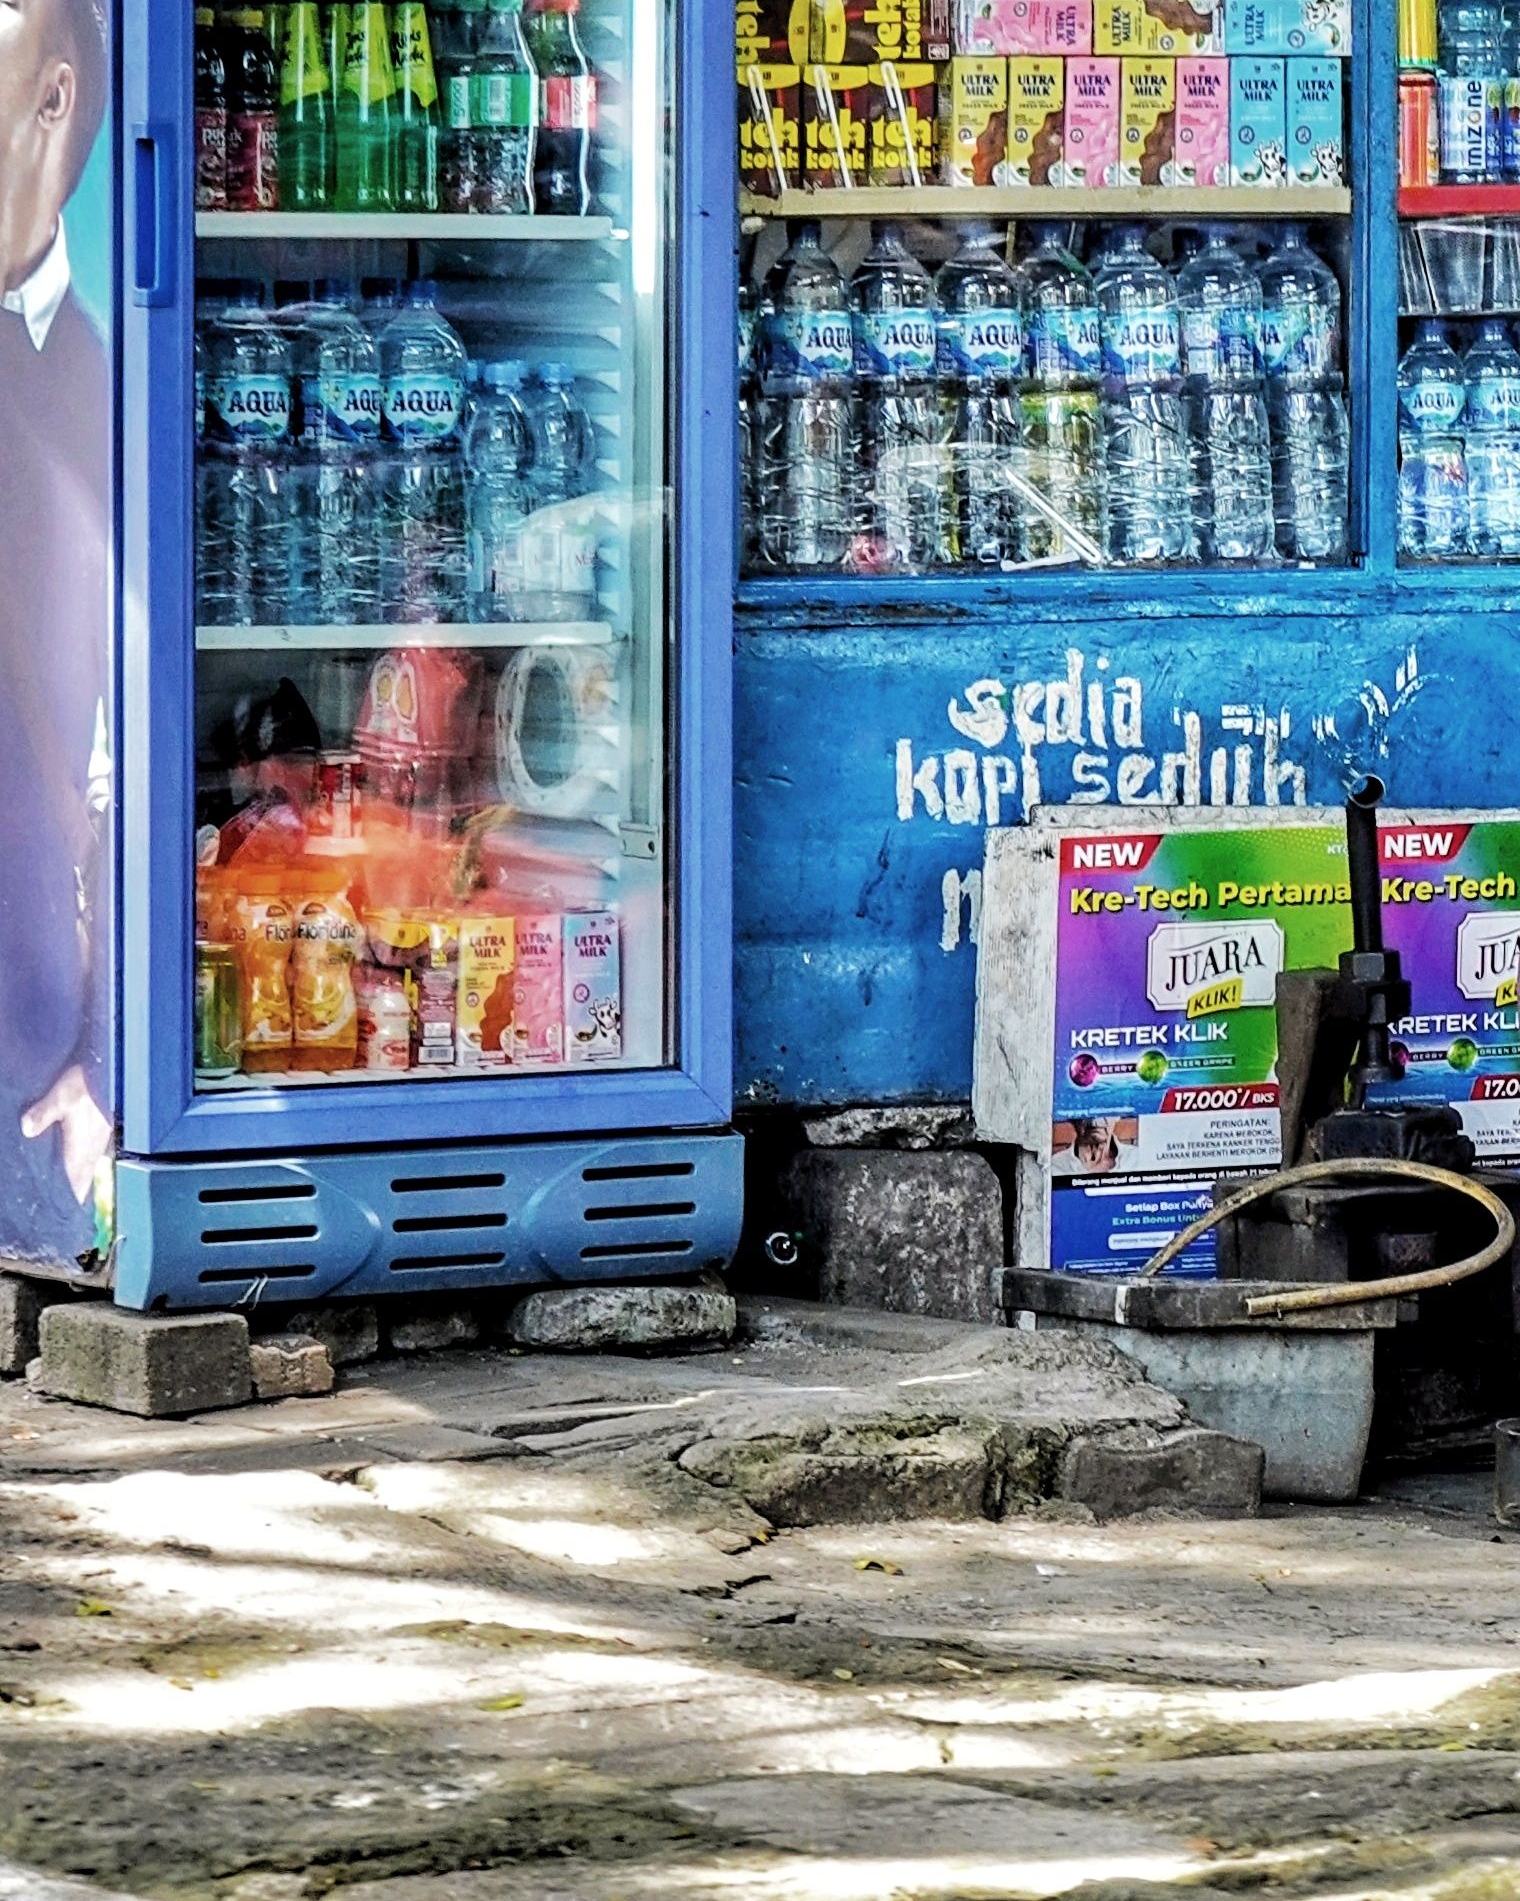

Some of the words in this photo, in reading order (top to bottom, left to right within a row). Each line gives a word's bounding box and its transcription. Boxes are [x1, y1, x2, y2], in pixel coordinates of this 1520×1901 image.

[1056, 10, 1064, 42] MILK
[1066, 5, 1078, 46] ULTRA
[1112, 5, 1122, 46] ULTRA
[1122, 11, 1131, 42] MILK
[1244, 3, 1256, 46] ULTRA
[1256, 9, 1265, 41] MILK
[961, 74, 999, 85] ULTRA
[1017, 74, 1055, 85] ULTRA
[1073, 74, 1111, 85] ULTRA
[1129, 74, 1167, 85] ULTRA
[1184, 74, 1221, 85] ULTRA
[1239, 79, 1278, 90] ULTRA
[1297, 79, 1335, 90] ULTRA
[966, 85, 994, 96] MILK
[1022, 85, 1050, 96] MILK
[1078, 85, 1106, 96] MILK
[1133, 85, 1162, 96] MILK
[1188, 85, 1215, 96] MILK
[1244, 90, 1273, 101] MILK
[1301, 90, 1330, 101] MILK
[1468, 80, 1482, 166] mizone
[806, 326, 851, 351] AQUA
[884, 324, 935, 349] AQUA
[969, 324, 1021, 349] AQUA
[1077, 322, 1100, 345] AQ
[1119, 323, 1175, 349] AQUA
[229, 388, 288, 416] AQUA
[345, 389, 381, 415] AQU
[392, 388, 452, 416] AQUA
[1412, 392, 1455, 411] AQUA
[948, 647, 1142, 748] sedia
[895, 737, 1040, 827] kopi
[1384, 832, 1454, 859] NEW
[1073, 842, 1144, 869] NEW
[1381, 871, 1516, 903] Kre-Tech
[1070, 881, 1208, 914] Kre-Tech
[1218, 881, 1352, 907] Pertama
[469, 935, 506, 948] ULTRA
[515, 932, 552, 945] ULTRA
[574, 934, 611, 947] ULTRA
[474, 947, 501, 958] MILK
[520, 945, 547, 957] MILK
[579, 946, 607, 958] MILK
[1165, 935, 1265, 992] JUARA
[1193, 985, 1237, 1011] KLIK!
[1484, 1012, 1520, 1031] KLI
[1071, 1025, 1168, 1048] KRETEK
[1174, 1022, 1228, 1043] KLIK
[1252, 1092, 1274, 1104] BKS
[1210, 1118, 1271, 1129] PERINGATAN:
[1204, 1130, 1234, 1139] KARENA
[1166, 1142, 1185, 1151] SAYA
[1125, 1202, 1158, 1214] Setiap
[1160, 1201, 1180, 1212] Box
[1112, 1216, 1141, 1226] Extra
[1142, 1215, 1176, 1225] Bonus
[1177, 1214, 1202, 1224] Unt
